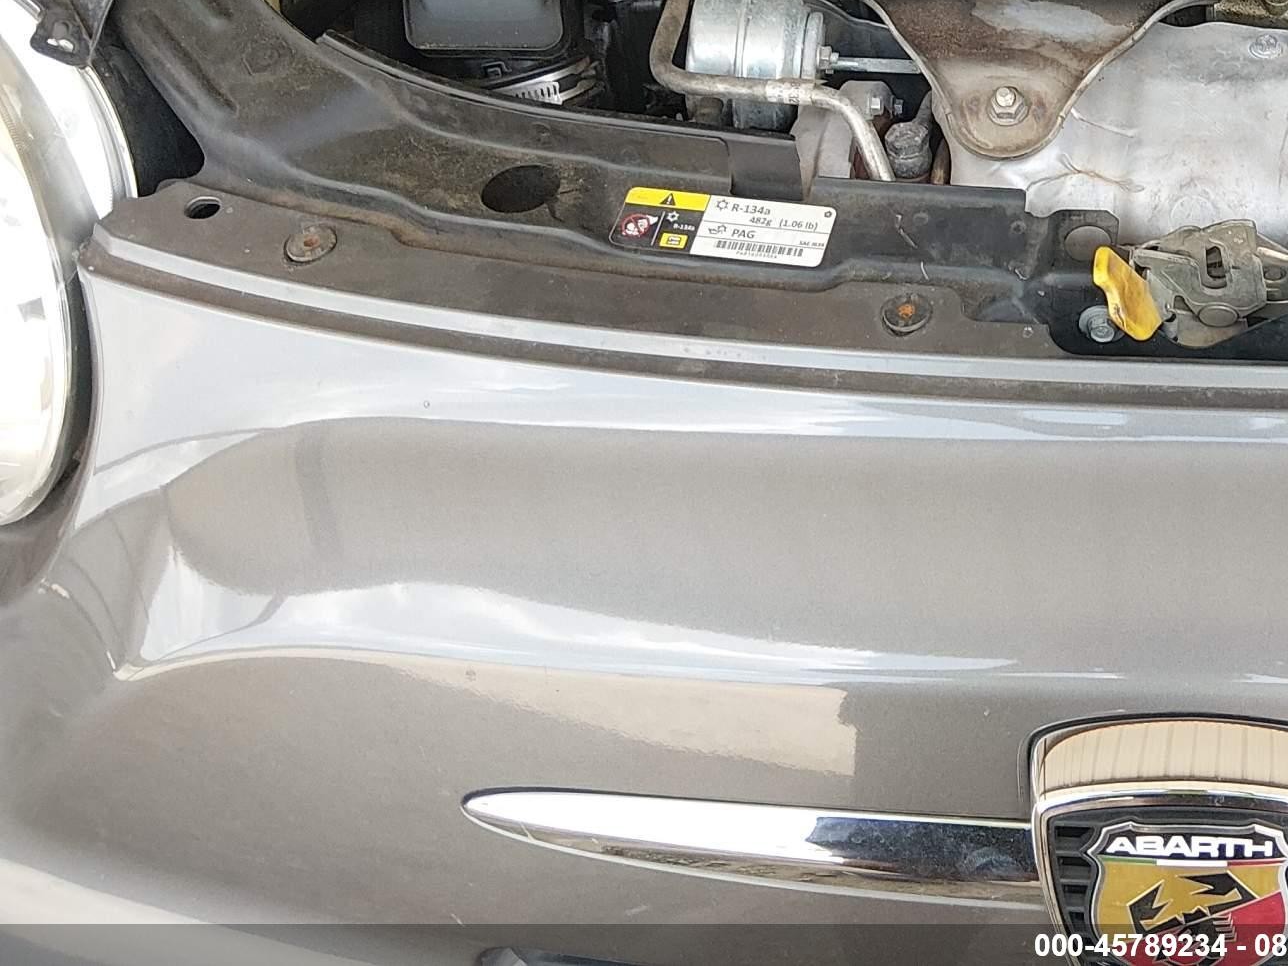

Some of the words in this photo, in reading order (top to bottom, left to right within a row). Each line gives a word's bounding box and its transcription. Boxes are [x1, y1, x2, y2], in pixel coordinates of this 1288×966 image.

[731, 203, 771, 216] R-134a
[749, 216, 773, 227] 482g
[779, 217, 805, 229] (1.06
[805, 219, 819, 231] lb)
[731, 228, 756, 240] PAG
[1106, 834, 1275, 859] ABARTH
